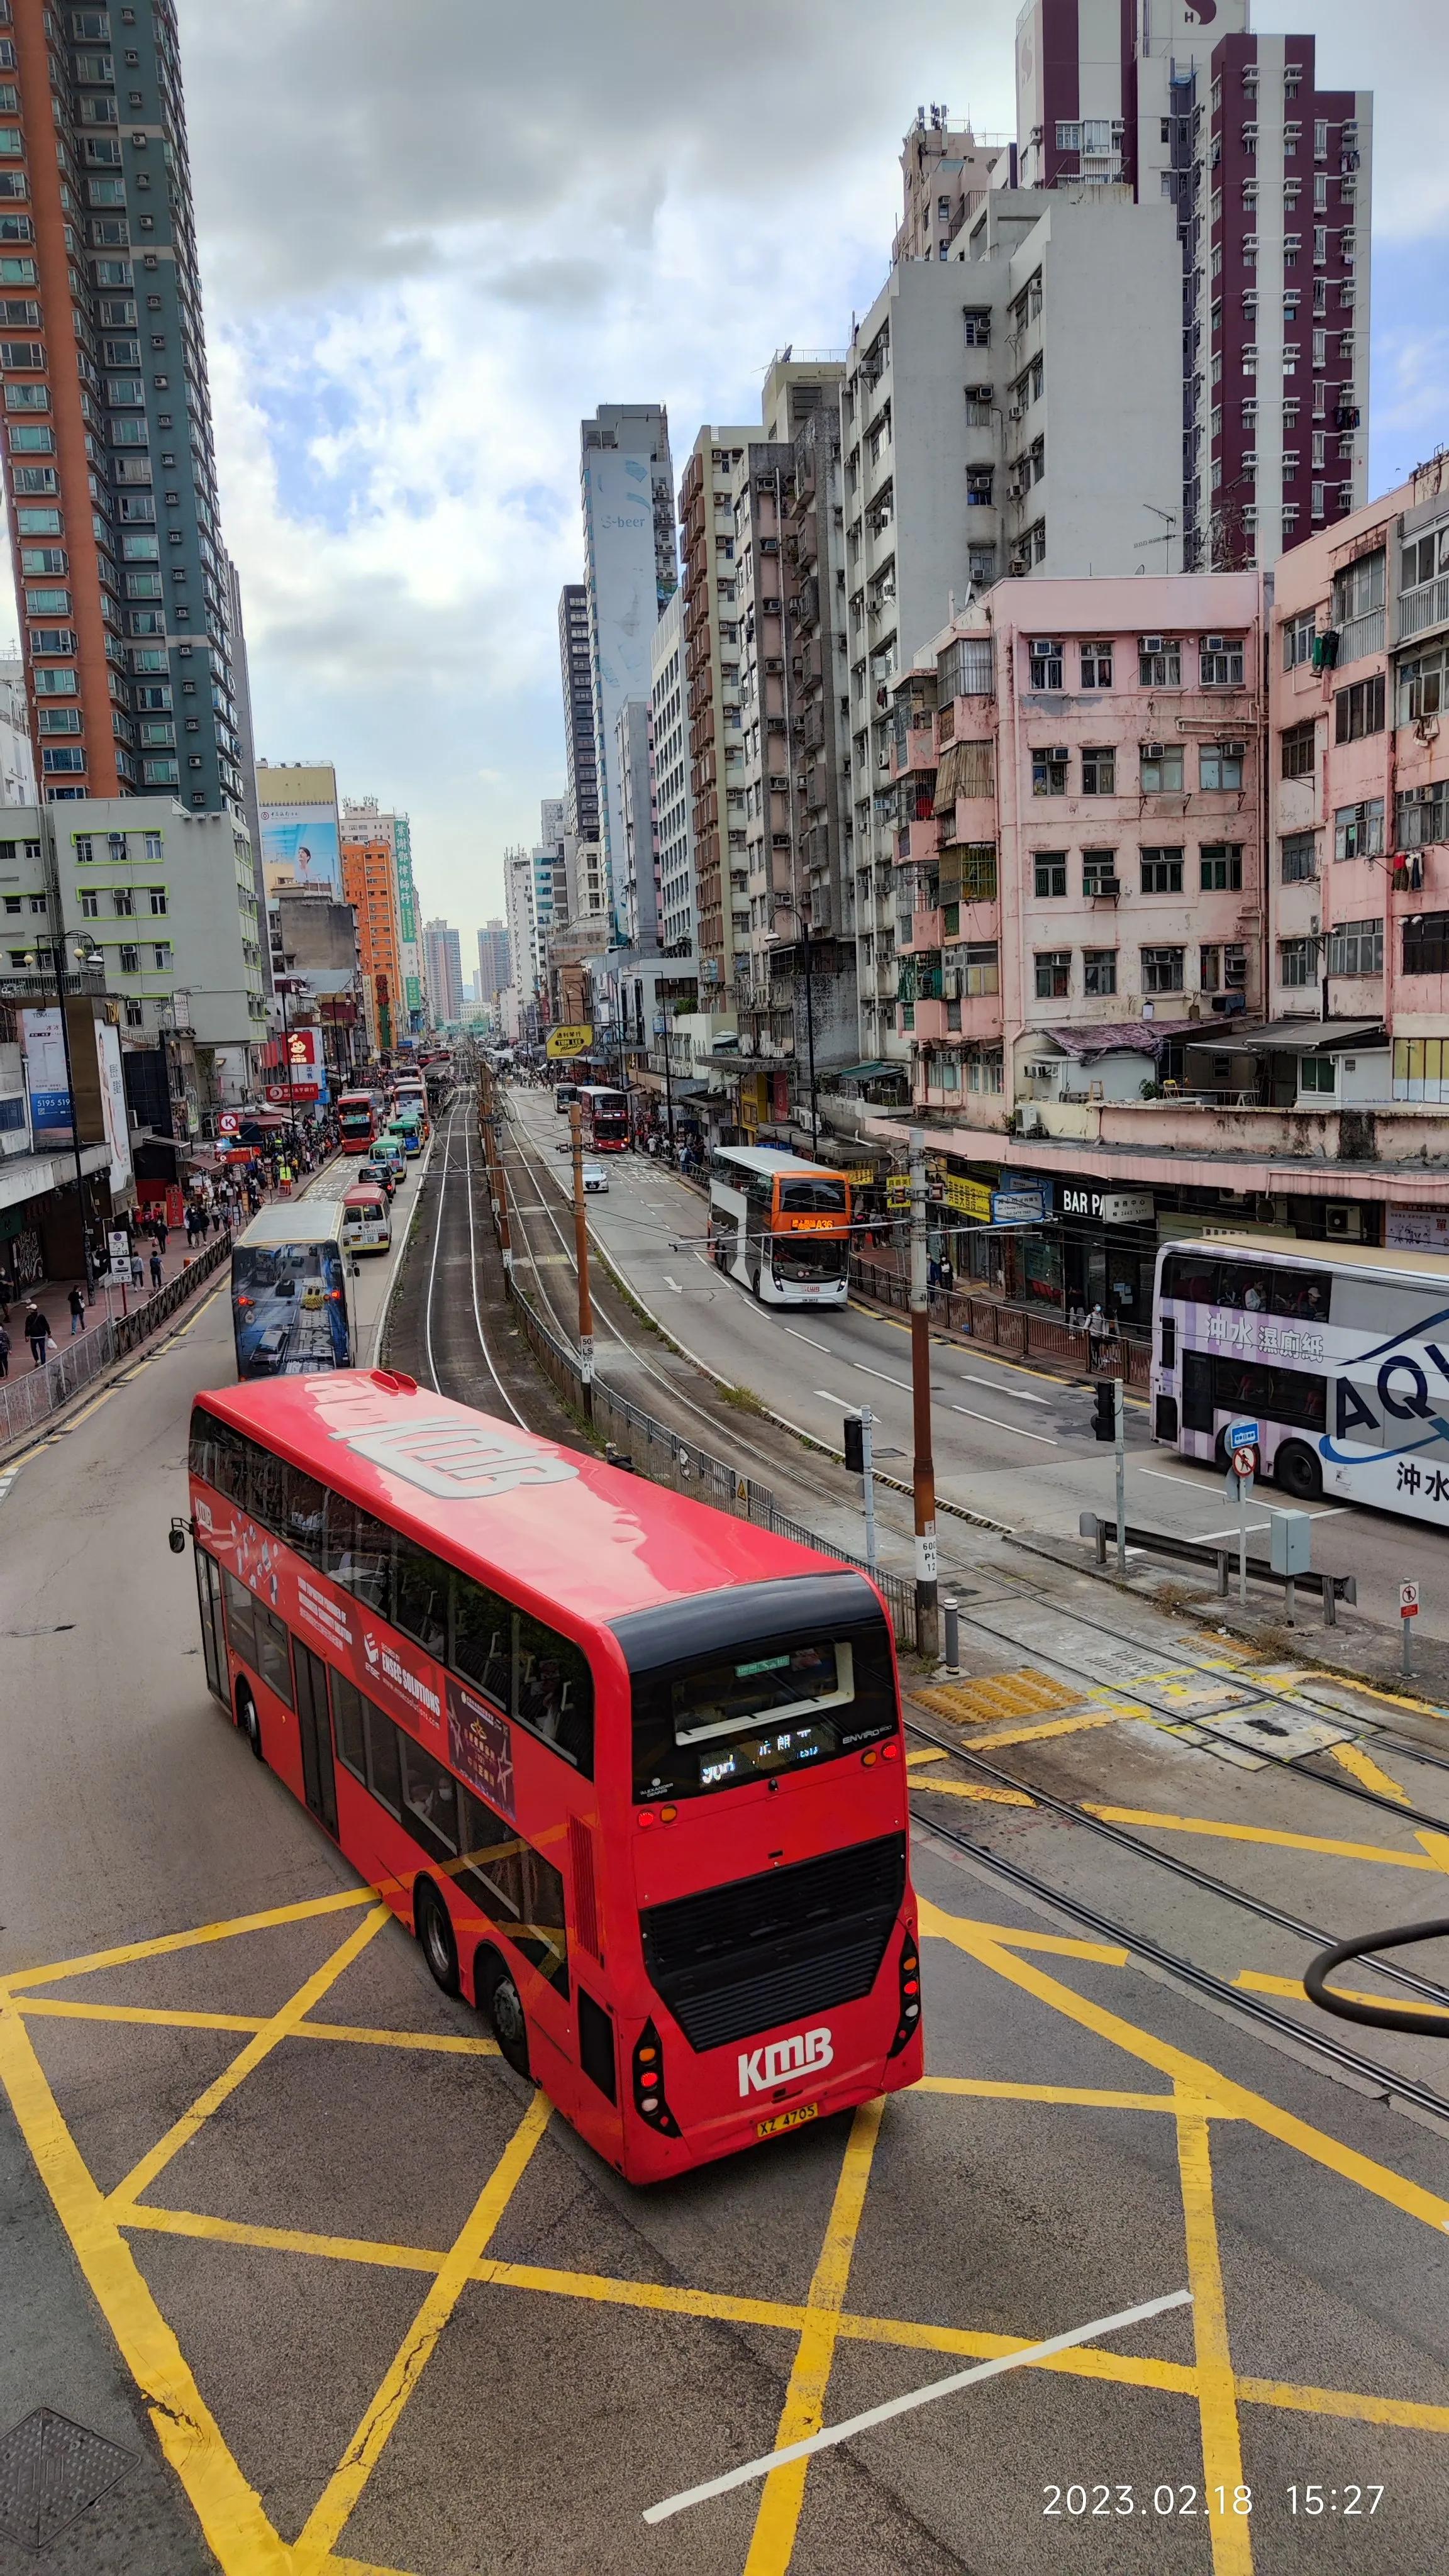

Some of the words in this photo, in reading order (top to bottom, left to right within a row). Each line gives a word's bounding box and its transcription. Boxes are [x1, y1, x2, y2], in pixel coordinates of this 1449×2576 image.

[1185, 11, 1194, 23] H
[37, 1099, 55, 1108] 5195
[1063, 1190, 1088, 1214] BAR
[924, 1552, 936, 1561] PL
[928, 1562, 936, 1572] 12
[382, 1652, 402, 1685] ENSEC
[402, 1668, 440, 1717] SOLUTIONS
[738, 2027, 834, 2097] KMB
[760, 2118, 776, 2135] XZ
[782, 2105, 816, 2126] 4705
